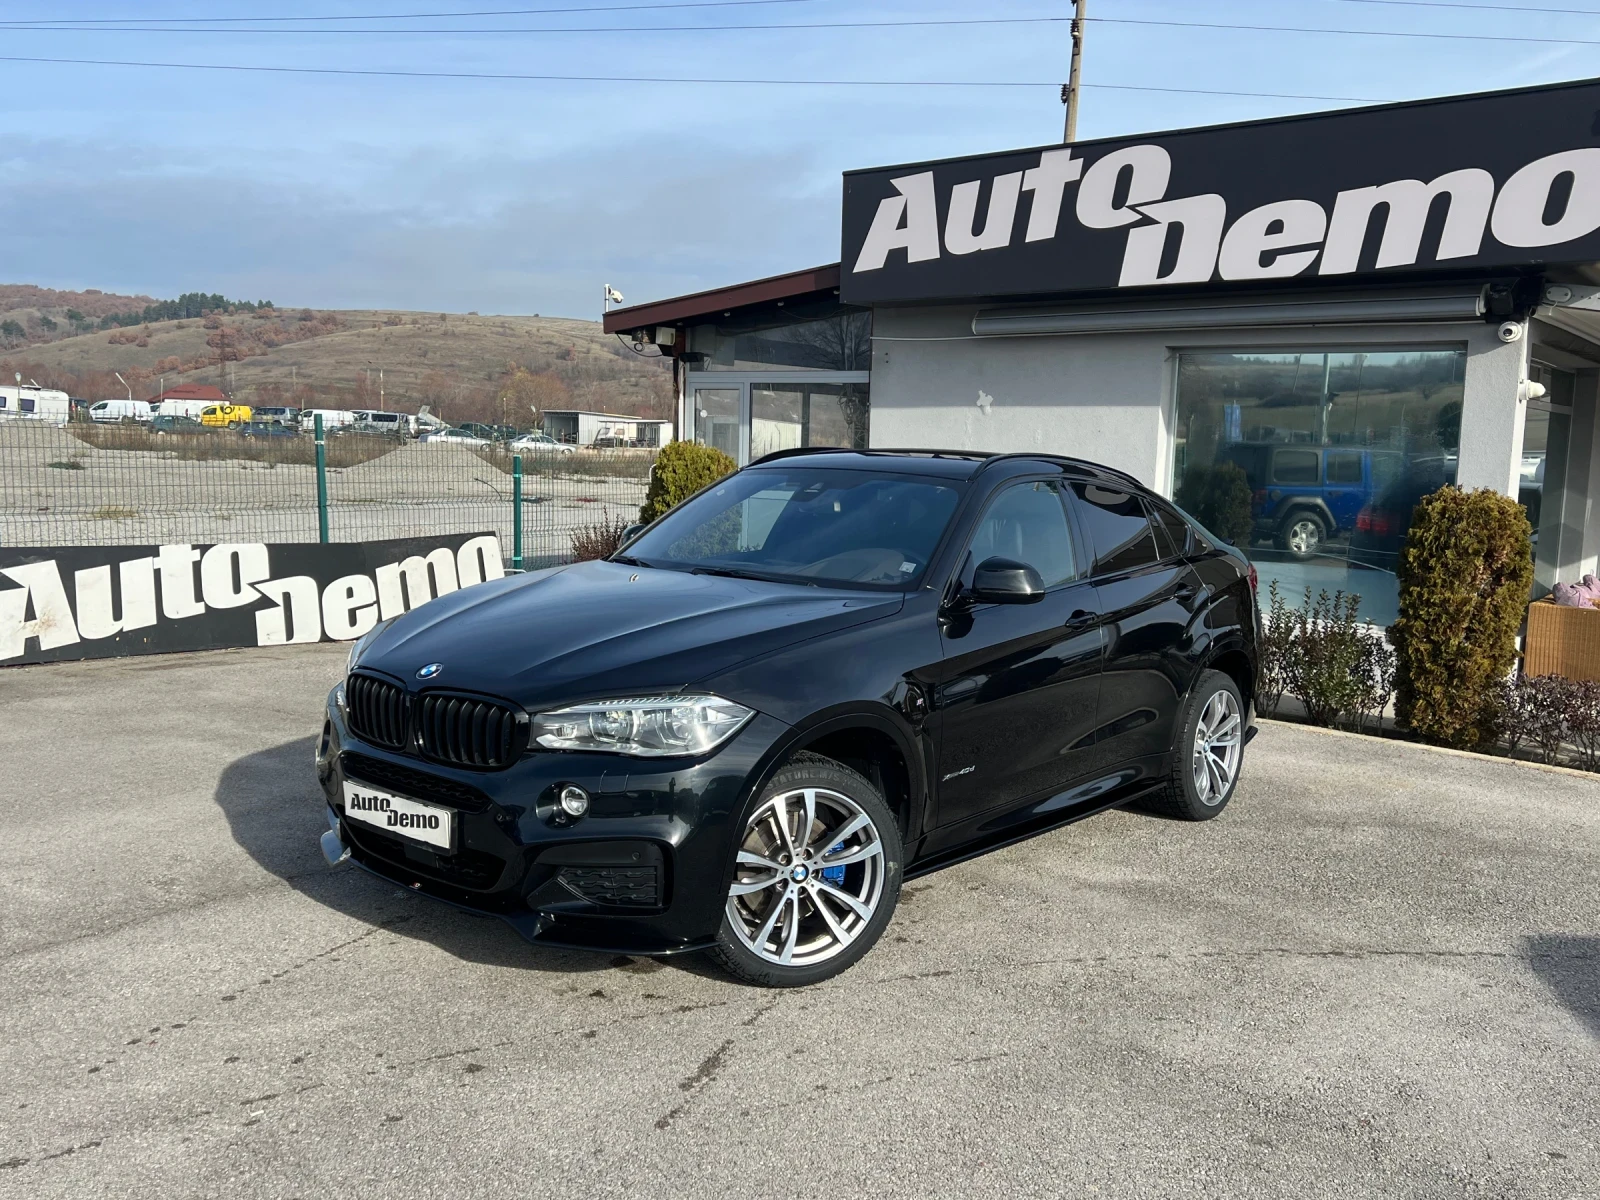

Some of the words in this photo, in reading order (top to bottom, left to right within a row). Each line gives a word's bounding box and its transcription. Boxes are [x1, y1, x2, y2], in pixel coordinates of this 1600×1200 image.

[853, 144, 1171, 272] Auto
[1118, 147, 1600, 287] Demo
[0, 543, 270, 661] Auto
[254, 535, 505, 647] Demo
[350, 793, 390, 812] Auto
[387, 809, 440, 829] Demo
